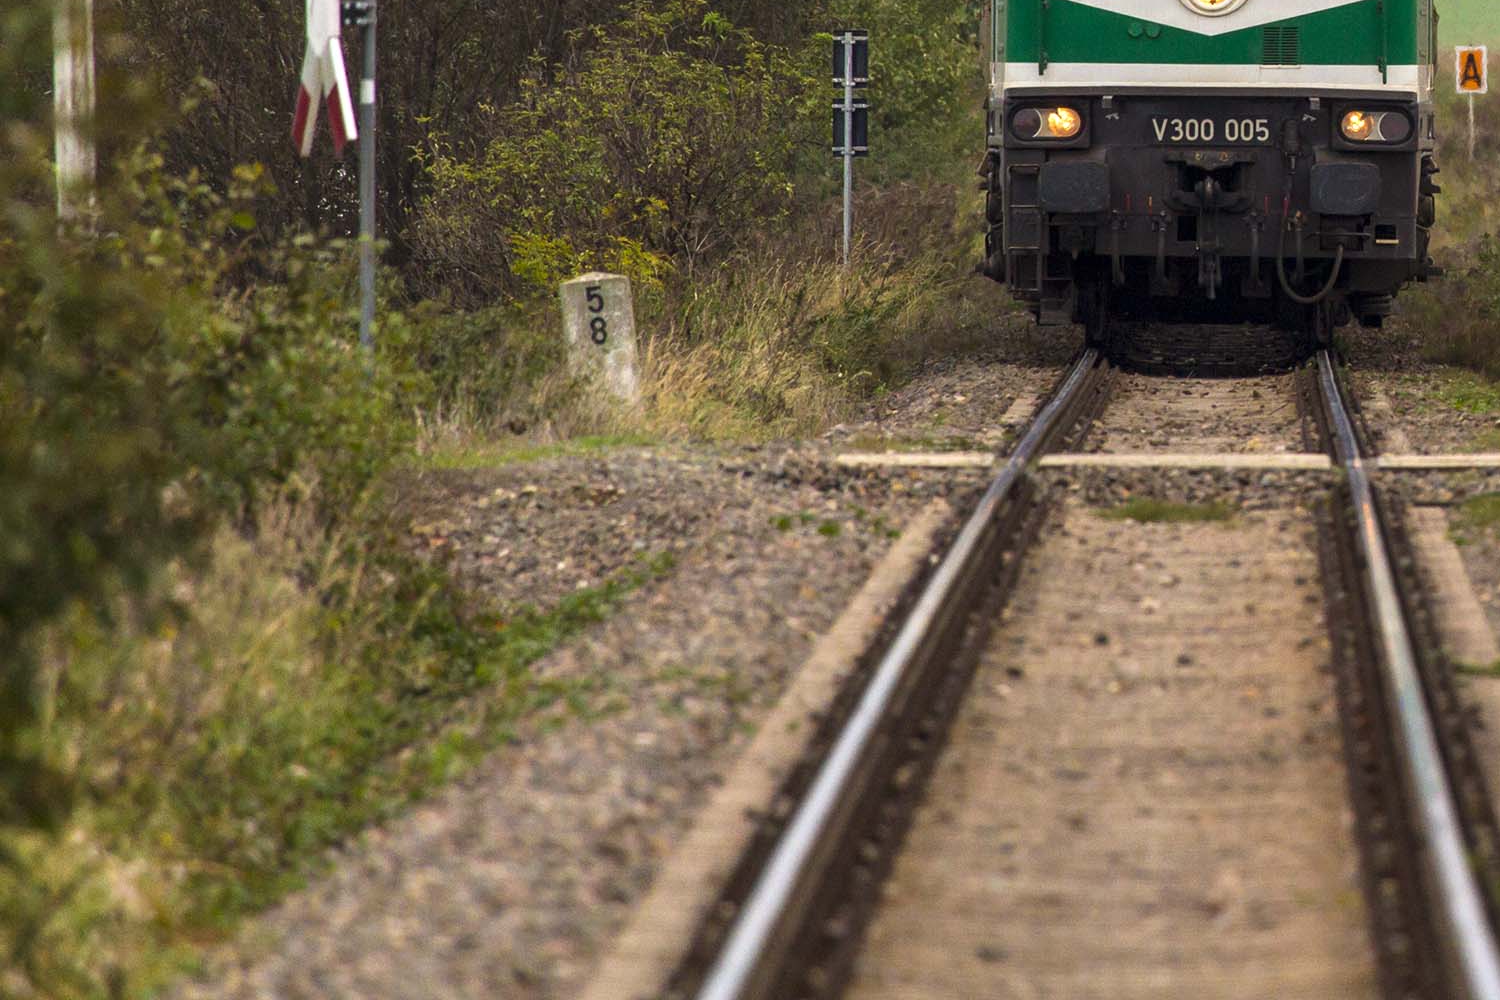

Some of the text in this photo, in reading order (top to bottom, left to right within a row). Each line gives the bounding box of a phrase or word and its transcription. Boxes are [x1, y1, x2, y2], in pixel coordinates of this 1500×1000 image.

[1460, 53, 1482, 89] A
[1152, 118, 1270, 141] V300 005
[585, 285, 605, 313] 5
[590, 316, 608, 345] 8
